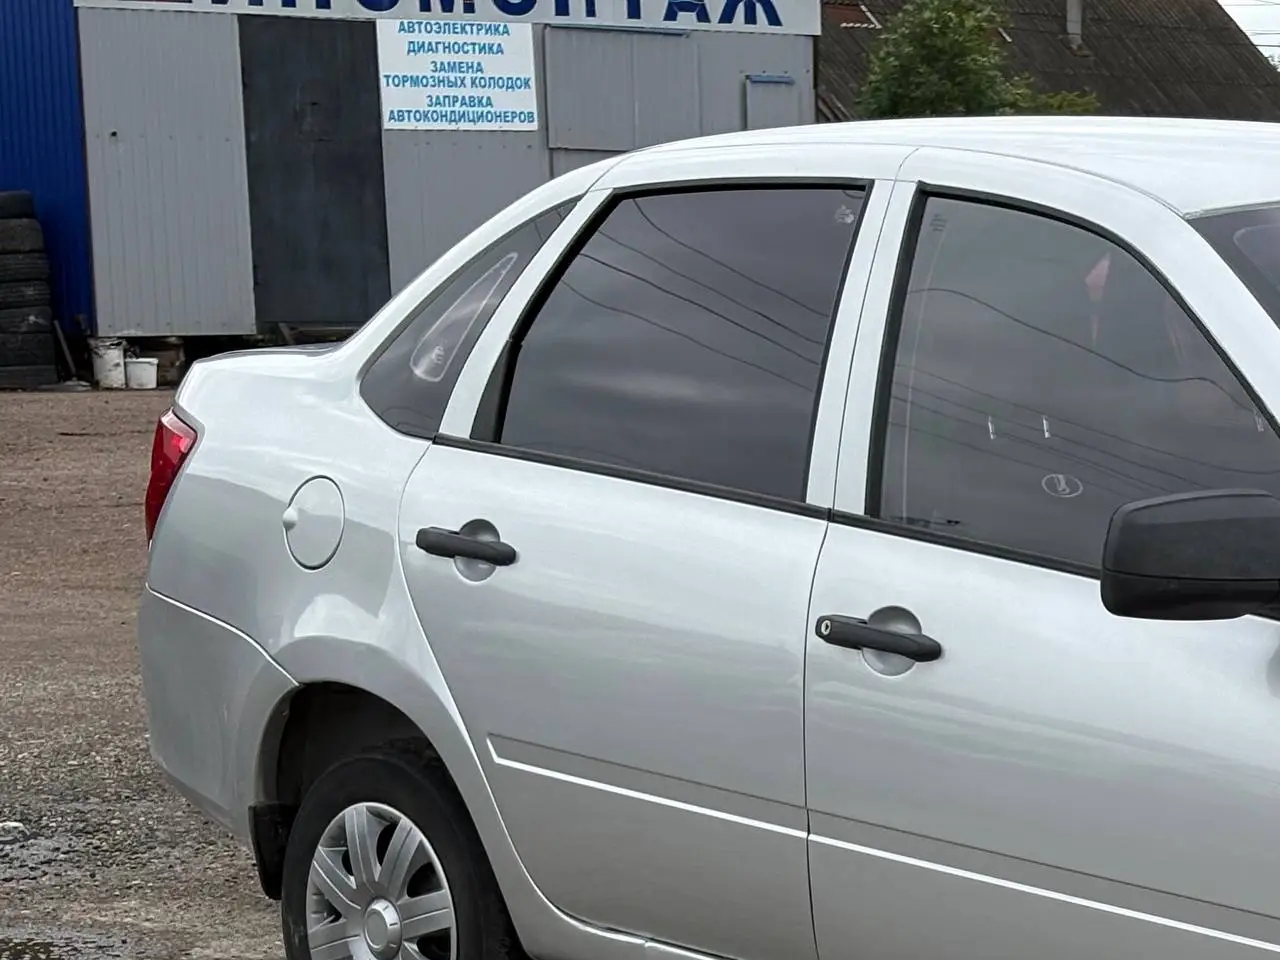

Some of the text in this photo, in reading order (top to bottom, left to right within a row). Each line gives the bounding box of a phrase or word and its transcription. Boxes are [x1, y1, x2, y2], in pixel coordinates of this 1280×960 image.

[398, 21, 510, 36] АВТОЭЛЕКТРИКА
[406, 41, 504, 55] ДИАГНОСТИКА
[430, 60, 484, 74] ЗАМЕНА
[383, 75, 531, 91] ТОРМОЗНЫХ КОЛОДОК
[426, 95, 493, 108] ЗАПРАВКА
[388, 109, 535, 125] АВТОКОНДИЦИОНЕРОВ
